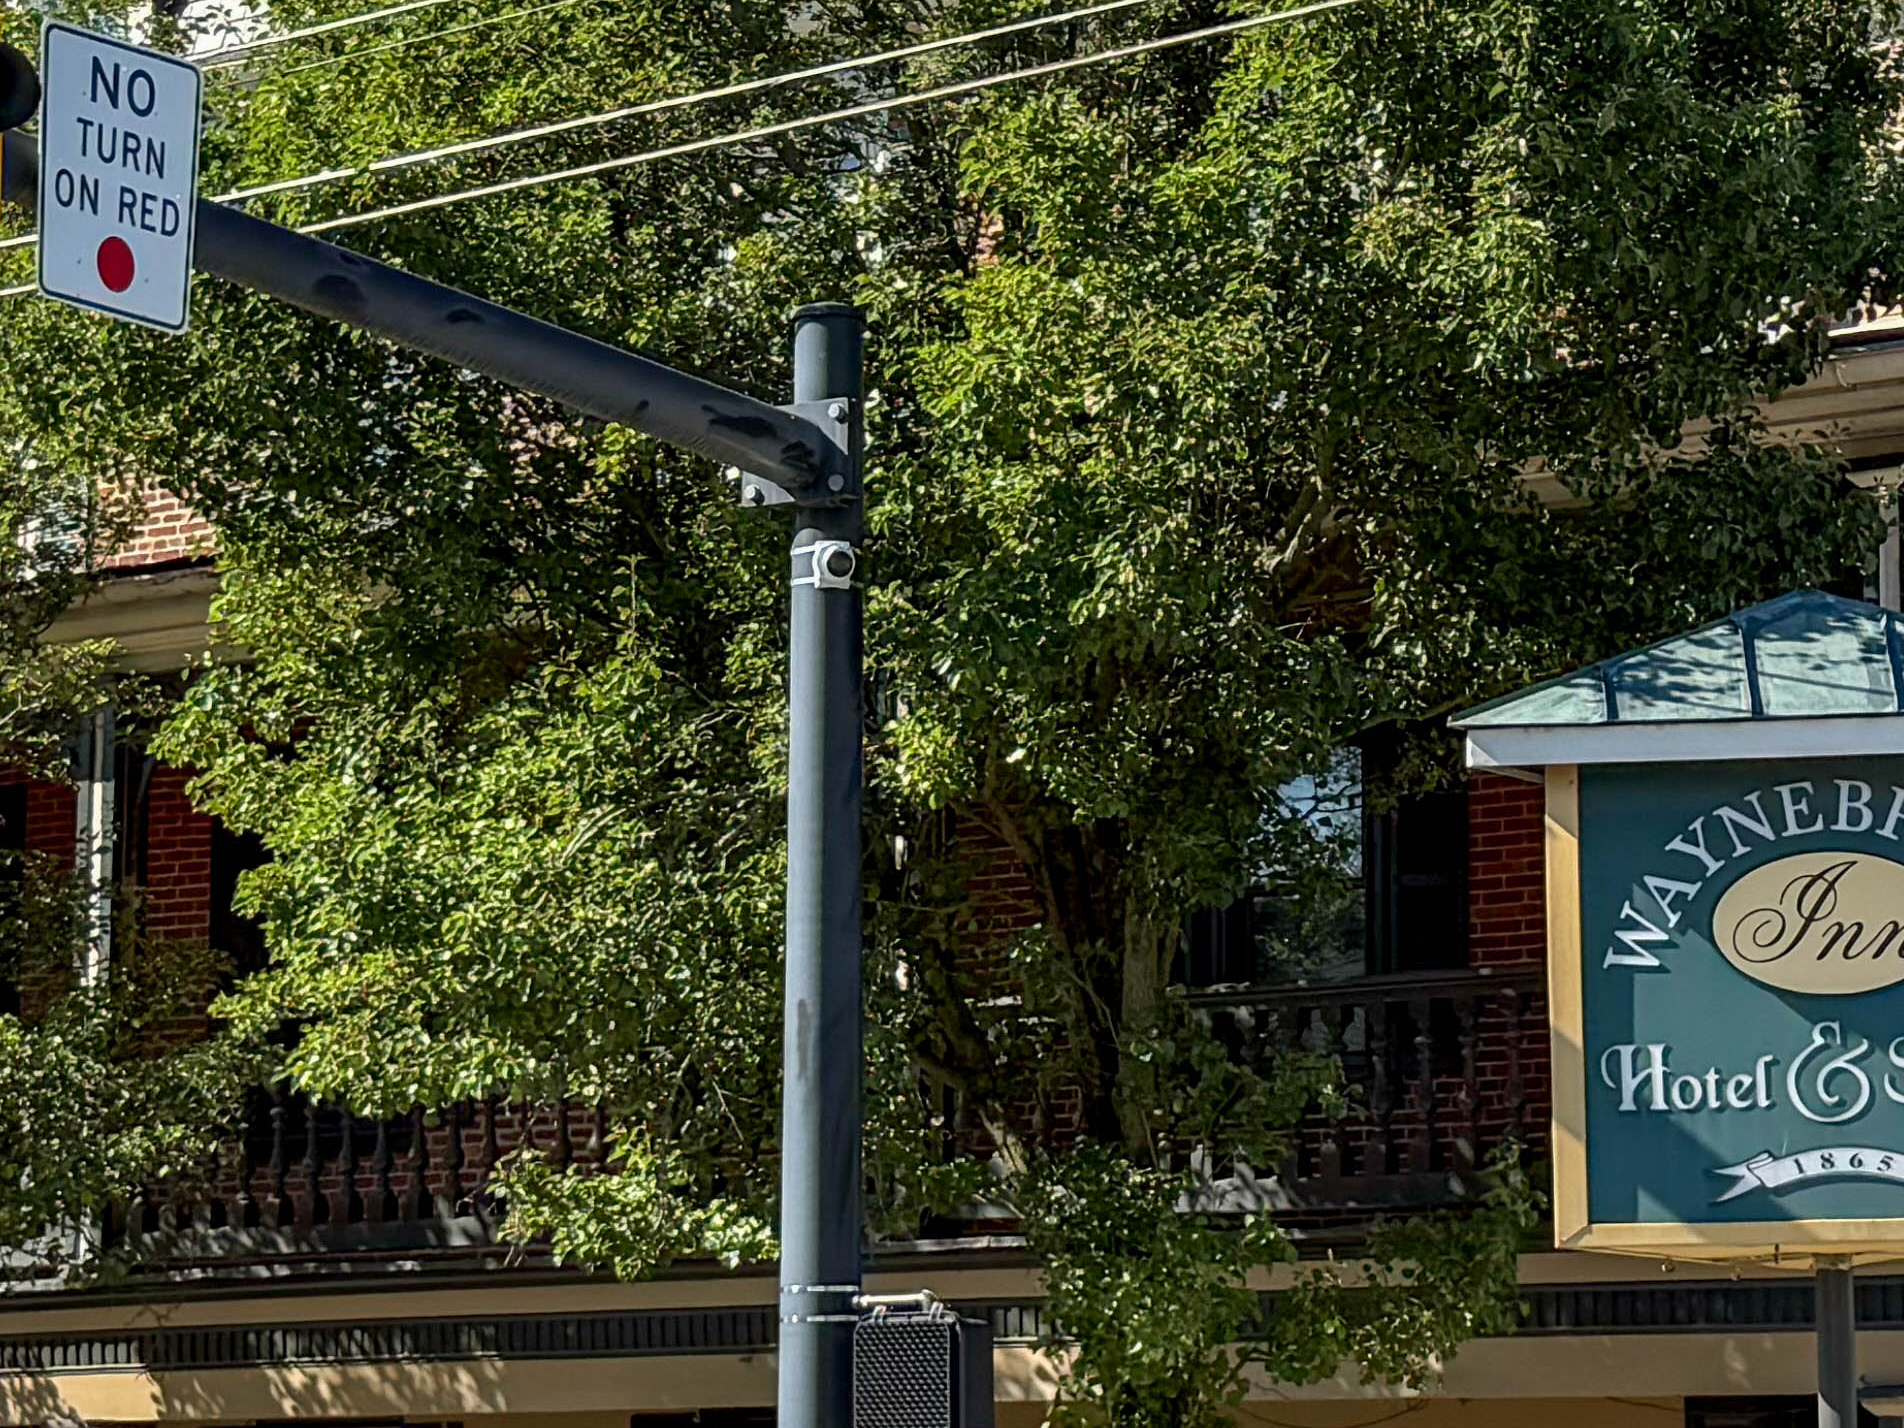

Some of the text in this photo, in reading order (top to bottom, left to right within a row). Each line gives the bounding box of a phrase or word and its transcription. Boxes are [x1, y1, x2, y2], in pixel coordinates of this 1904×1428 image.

[90, 56, 156, 117] NO
[76, 117, 166, 179] TURN
[55, 168, 180, 237] ON RED
[1601, 1043, 1773, 1111] Hotel
[1786, 1021, 1871, 1122] &
[1794, 1151, 1894, 1174] 1865
